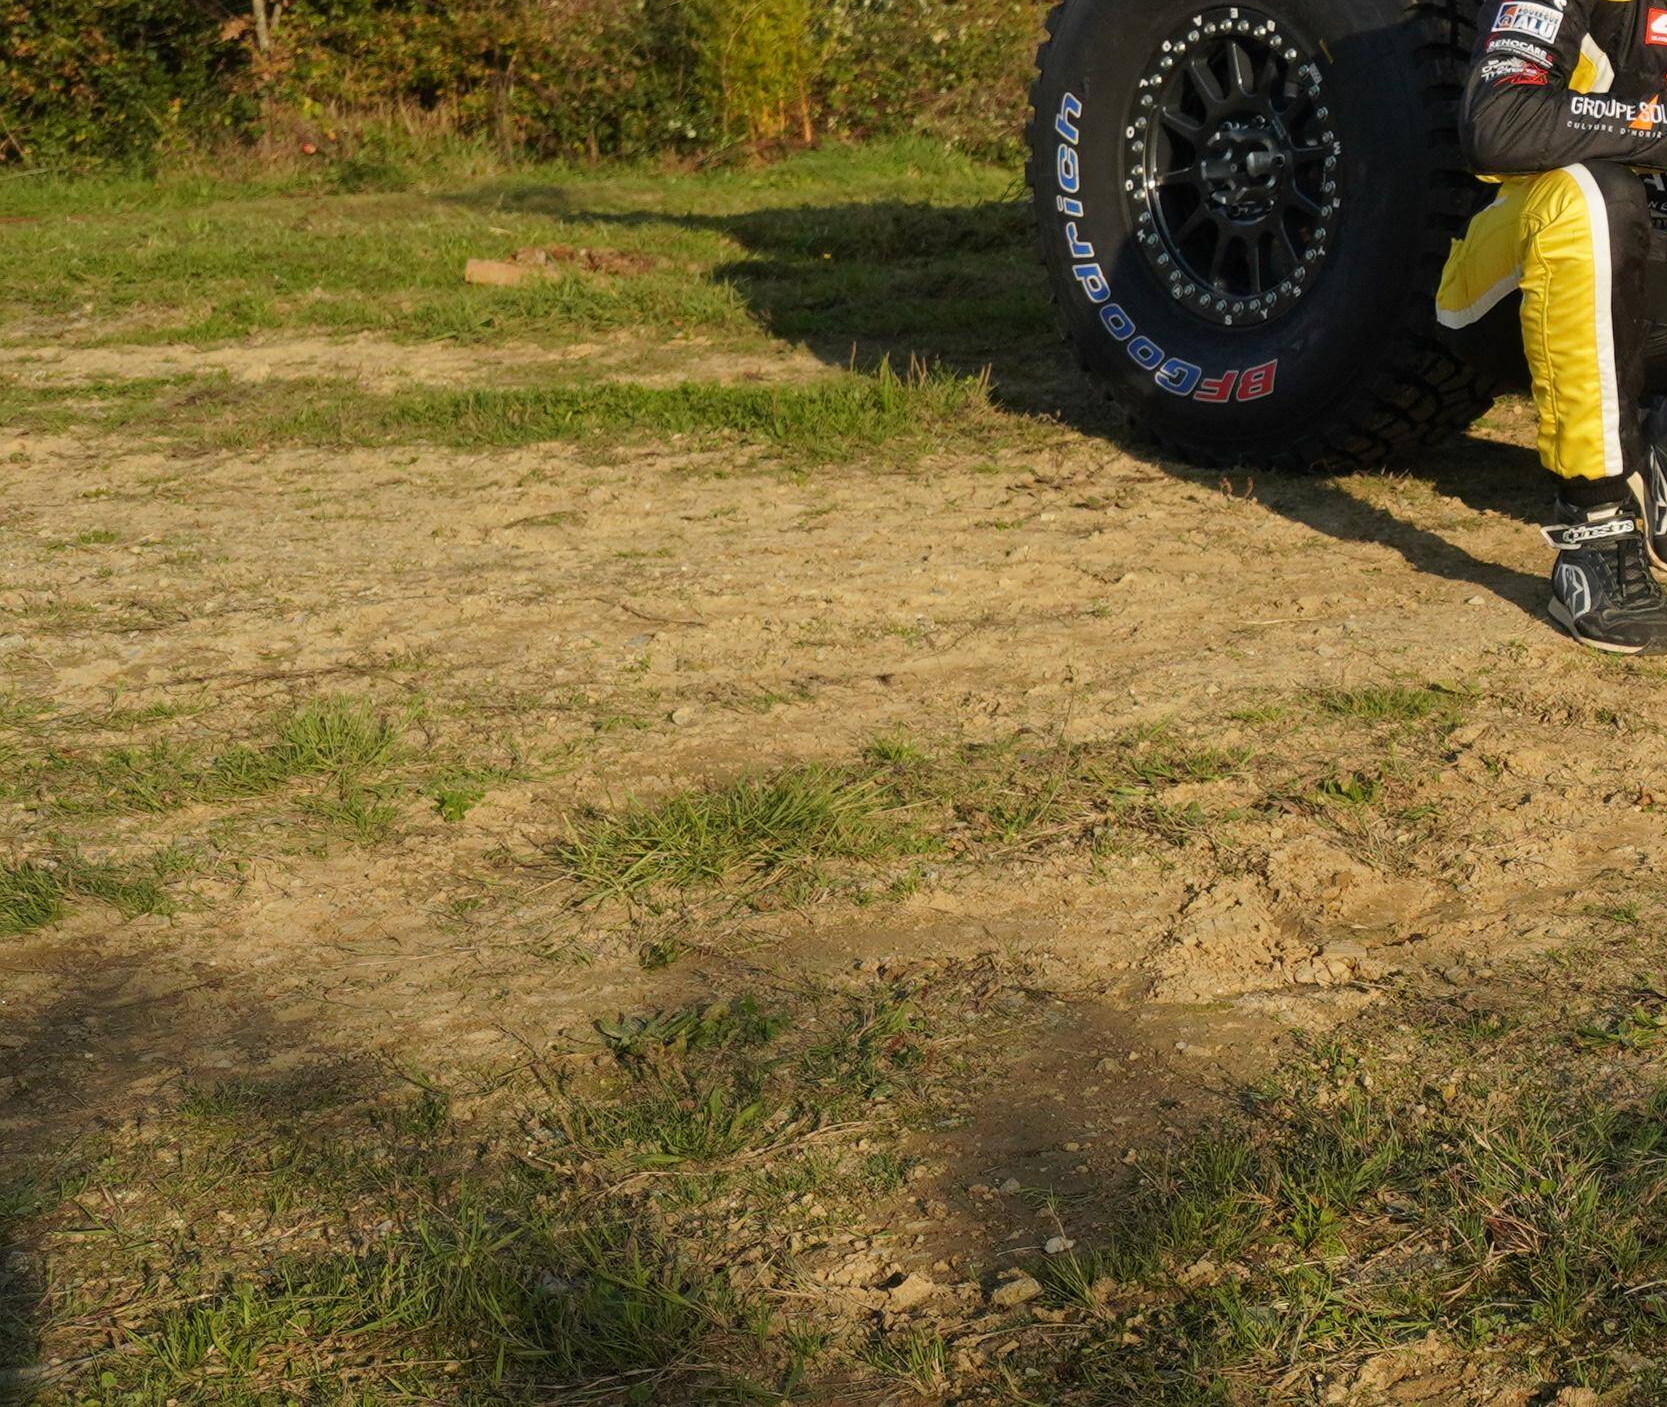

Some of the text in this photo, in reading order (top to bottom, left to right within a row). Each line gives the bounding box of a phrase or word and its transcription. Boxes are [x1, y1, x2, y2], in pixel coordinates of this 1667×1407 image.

[1515, 15, 1557, 38] ALU
[1570, 96, 1637, 122] GROUPE
[1054, 90, 1279, 404] BFGoodrich
